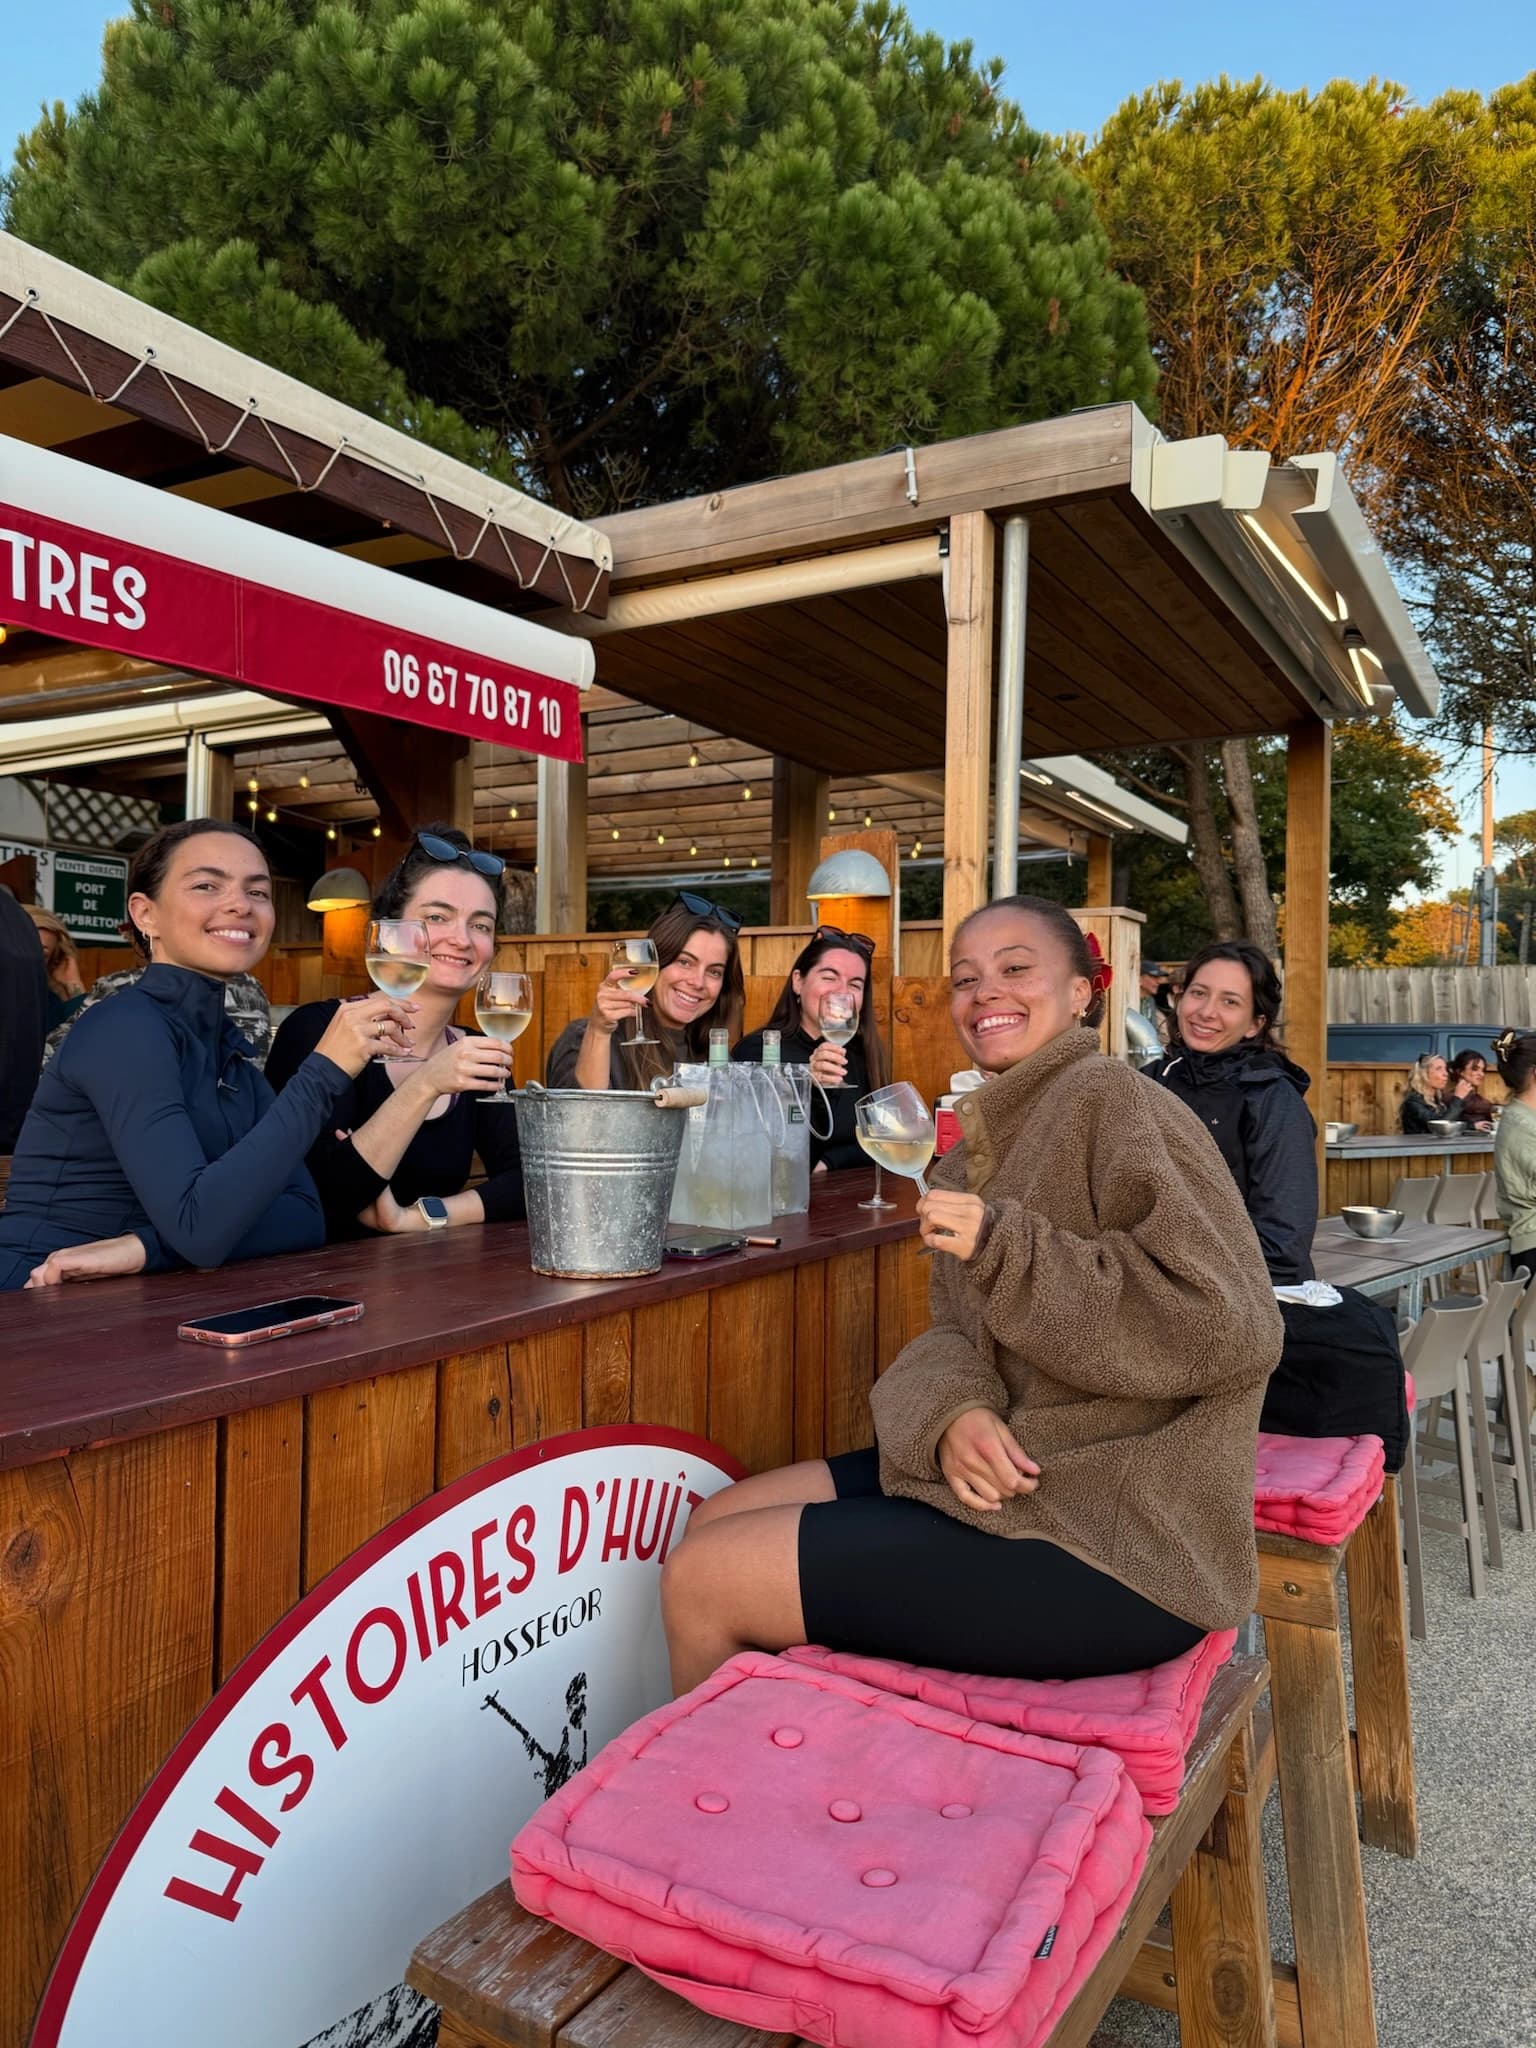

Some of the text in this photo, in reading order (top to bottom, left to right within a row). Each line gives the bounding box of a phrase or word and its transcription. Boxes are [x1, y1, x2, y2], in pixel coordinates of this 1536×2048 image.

[0, 528, 146, 630] TRES
[383, 648, 561, 738] 06 67 70 87 10
[57, 861, 126, 878] VENTE DIRECTE
[75, 882, 106, 896] PORT
[82, 899, 98, 911] DE
[462, 1588, 602, 1687] HOSSEGOR
[163, 1504, 537, 1922] HISTOIRES
